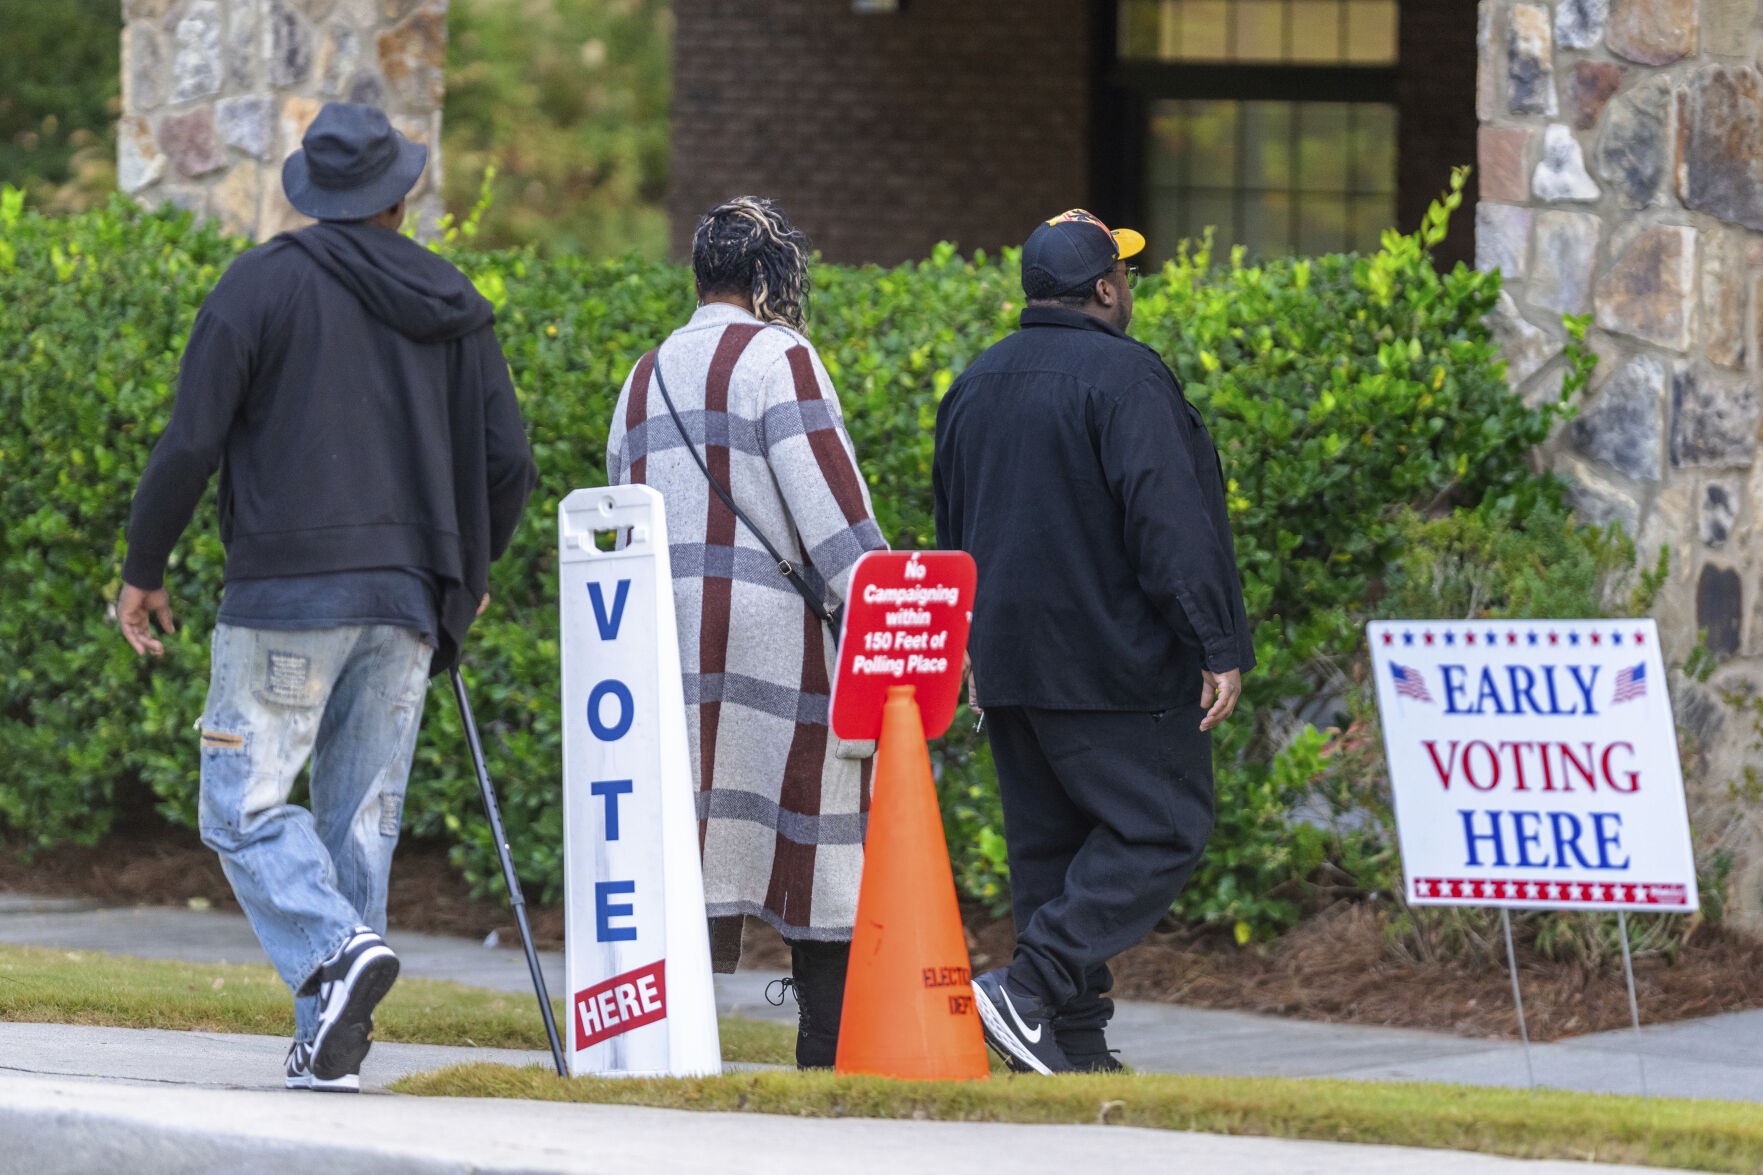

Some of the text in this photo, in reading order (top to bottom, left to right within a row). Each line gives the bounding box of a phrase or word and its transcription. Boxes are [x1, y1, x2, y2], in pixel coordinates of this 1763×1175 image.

[904, 560, 927, 579] No
[863, 583, 960, 606] Campaigning
[885, 607, 932, 627] within
[864, 630, 948, 651] 150 Feet of
[852, 654, 948, 678] Polling Place
[1438, 664, 1602, 717] EARLY
[586, 579, 638, 943] VOTE
[1421, 740, 1641, 793] VOTING
[1457, 809, 1631, 871] HERE
[577, 974, 663, 1038] HERE
